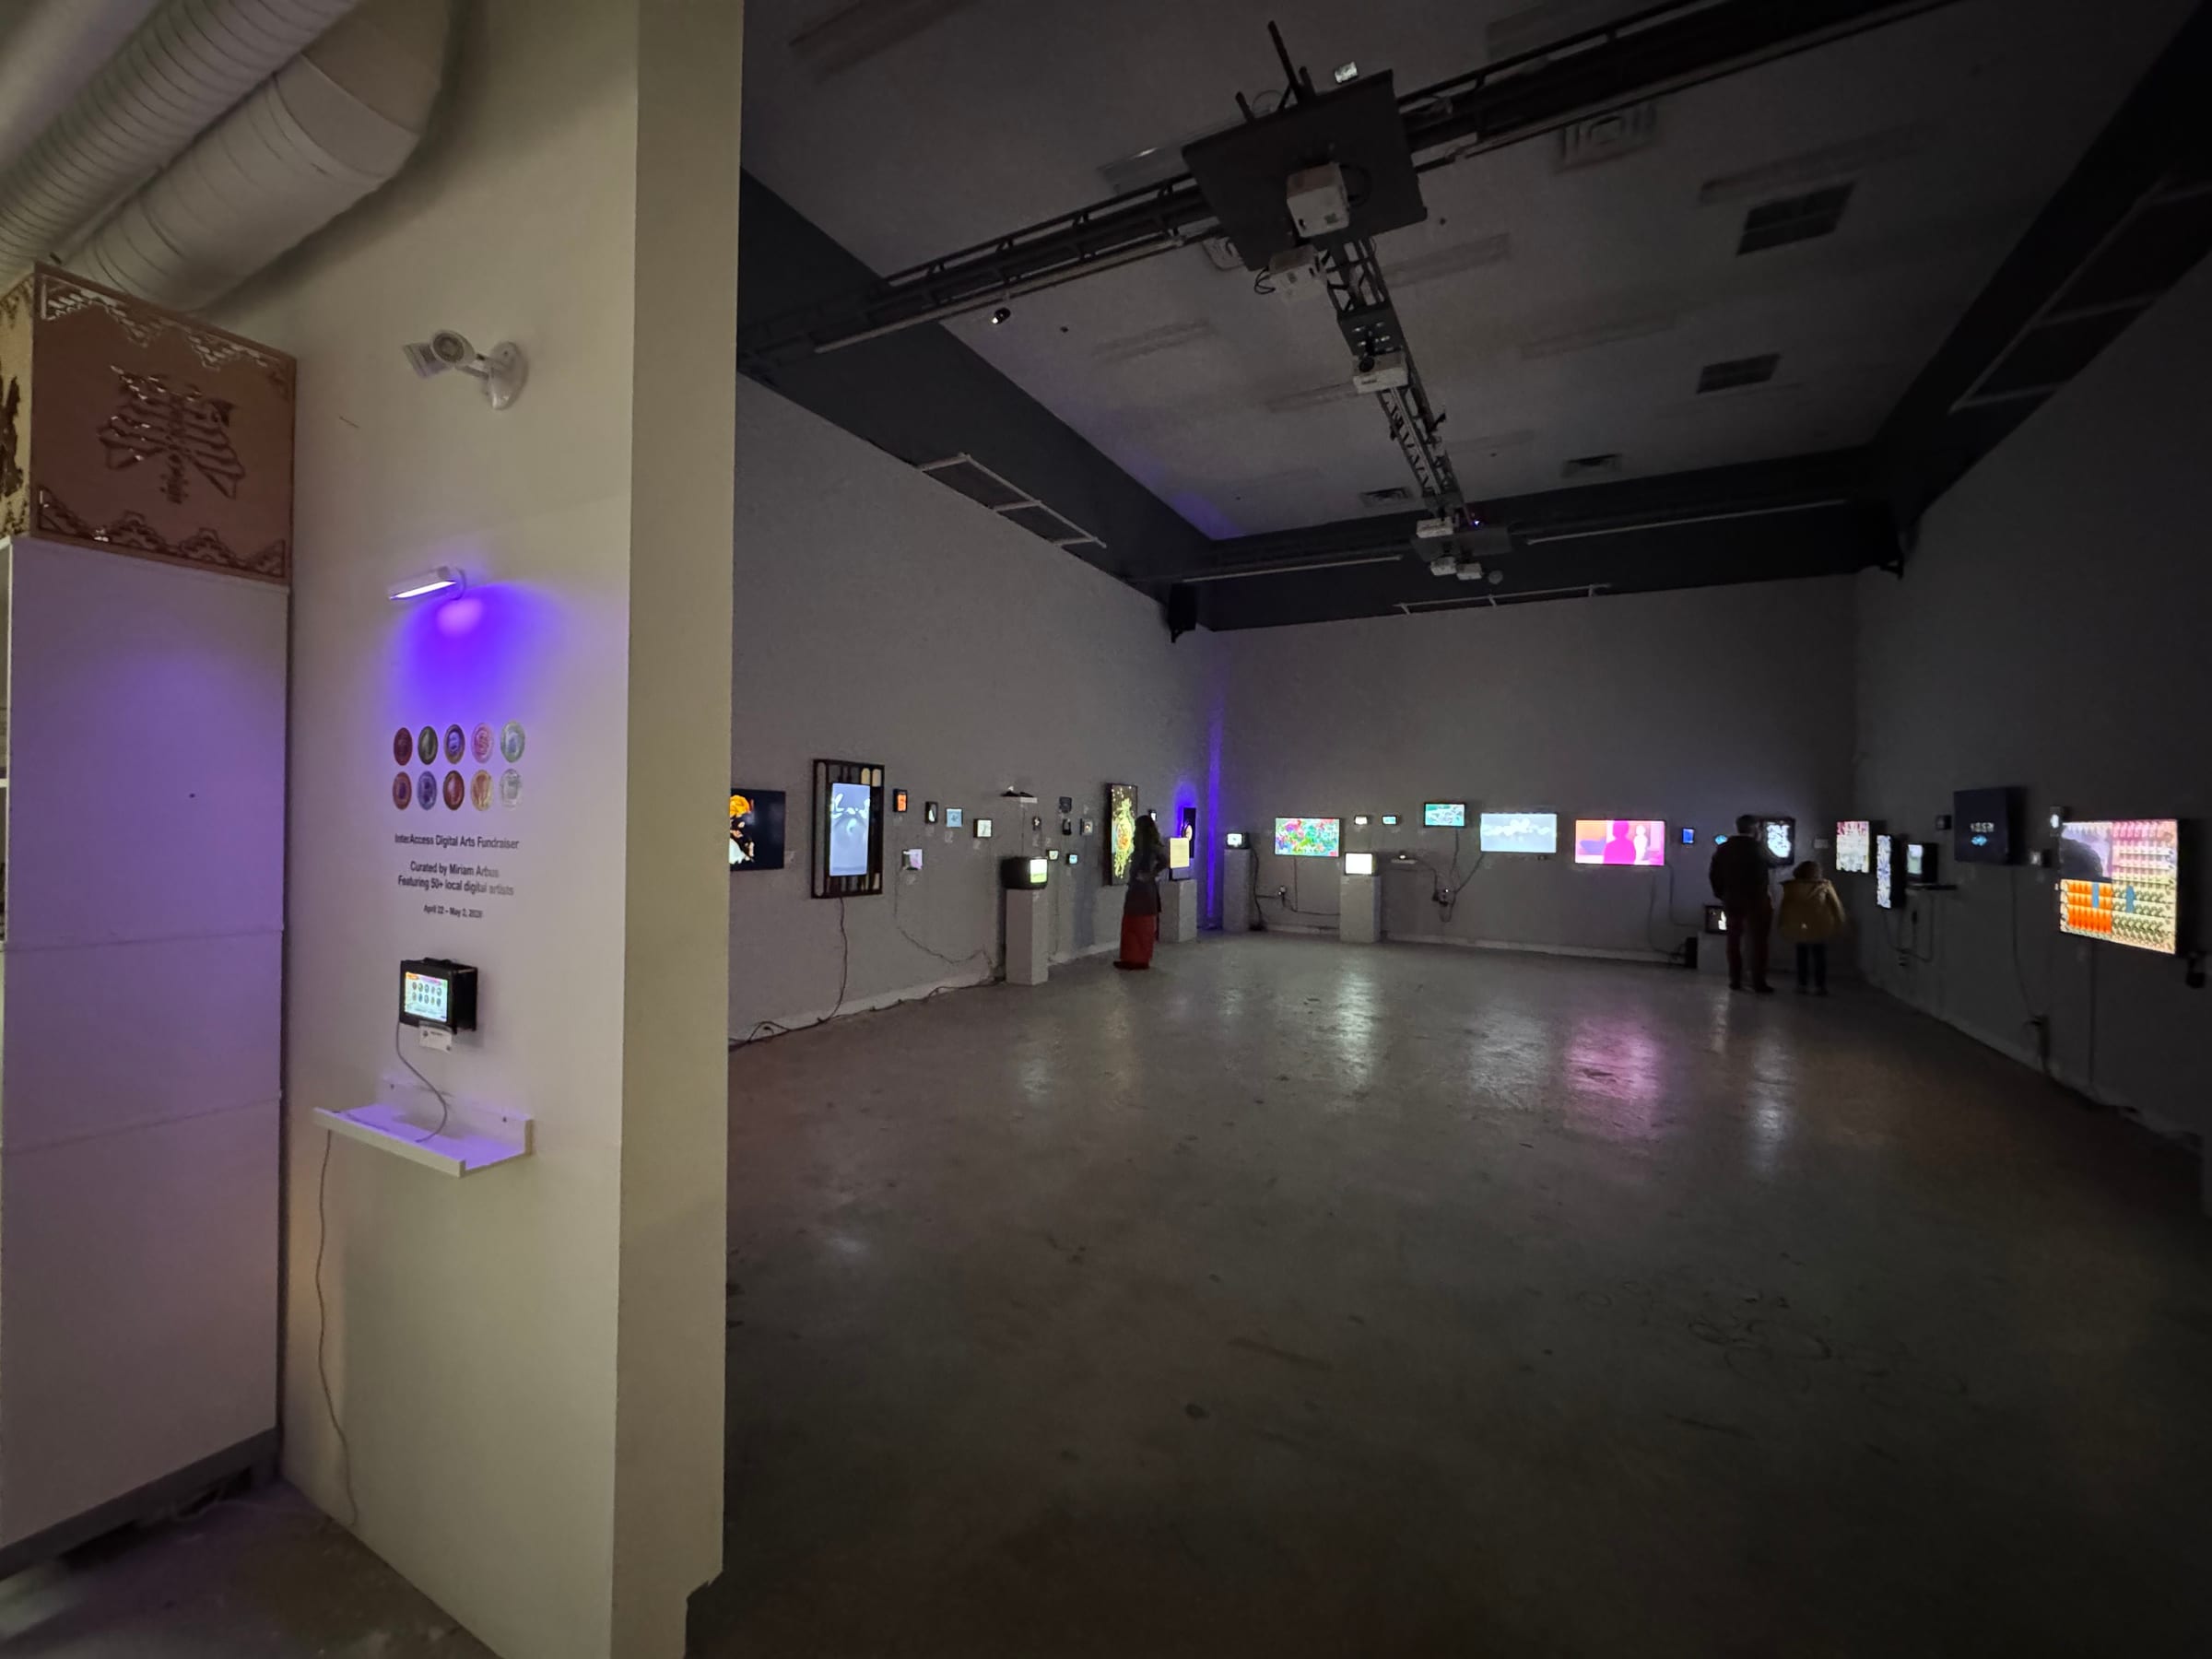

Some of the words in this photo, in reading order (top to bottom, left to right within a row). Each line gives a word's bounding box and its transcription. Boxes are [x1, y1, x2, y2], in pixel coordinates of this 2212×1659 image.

[394, 833, 434, 845] InterAccess
[436, 834, 458, 848] Digital
[460, 836, 475, 847] Arts
[477, 836, 520, 849] Fundraiser
[410, 861, 437, 873] Curated
[439, 863, 447, 876] by
[449, 864, 474, 875] Miriam
[398, 875, 429, 890] Featuring
[430, 877, 443, 888] 50+
[445, 879, 462, 890] local
[464, 881, 487, 895] digital
[489, 885, 514, 896] artists
[423, 904, 436, 914] April
